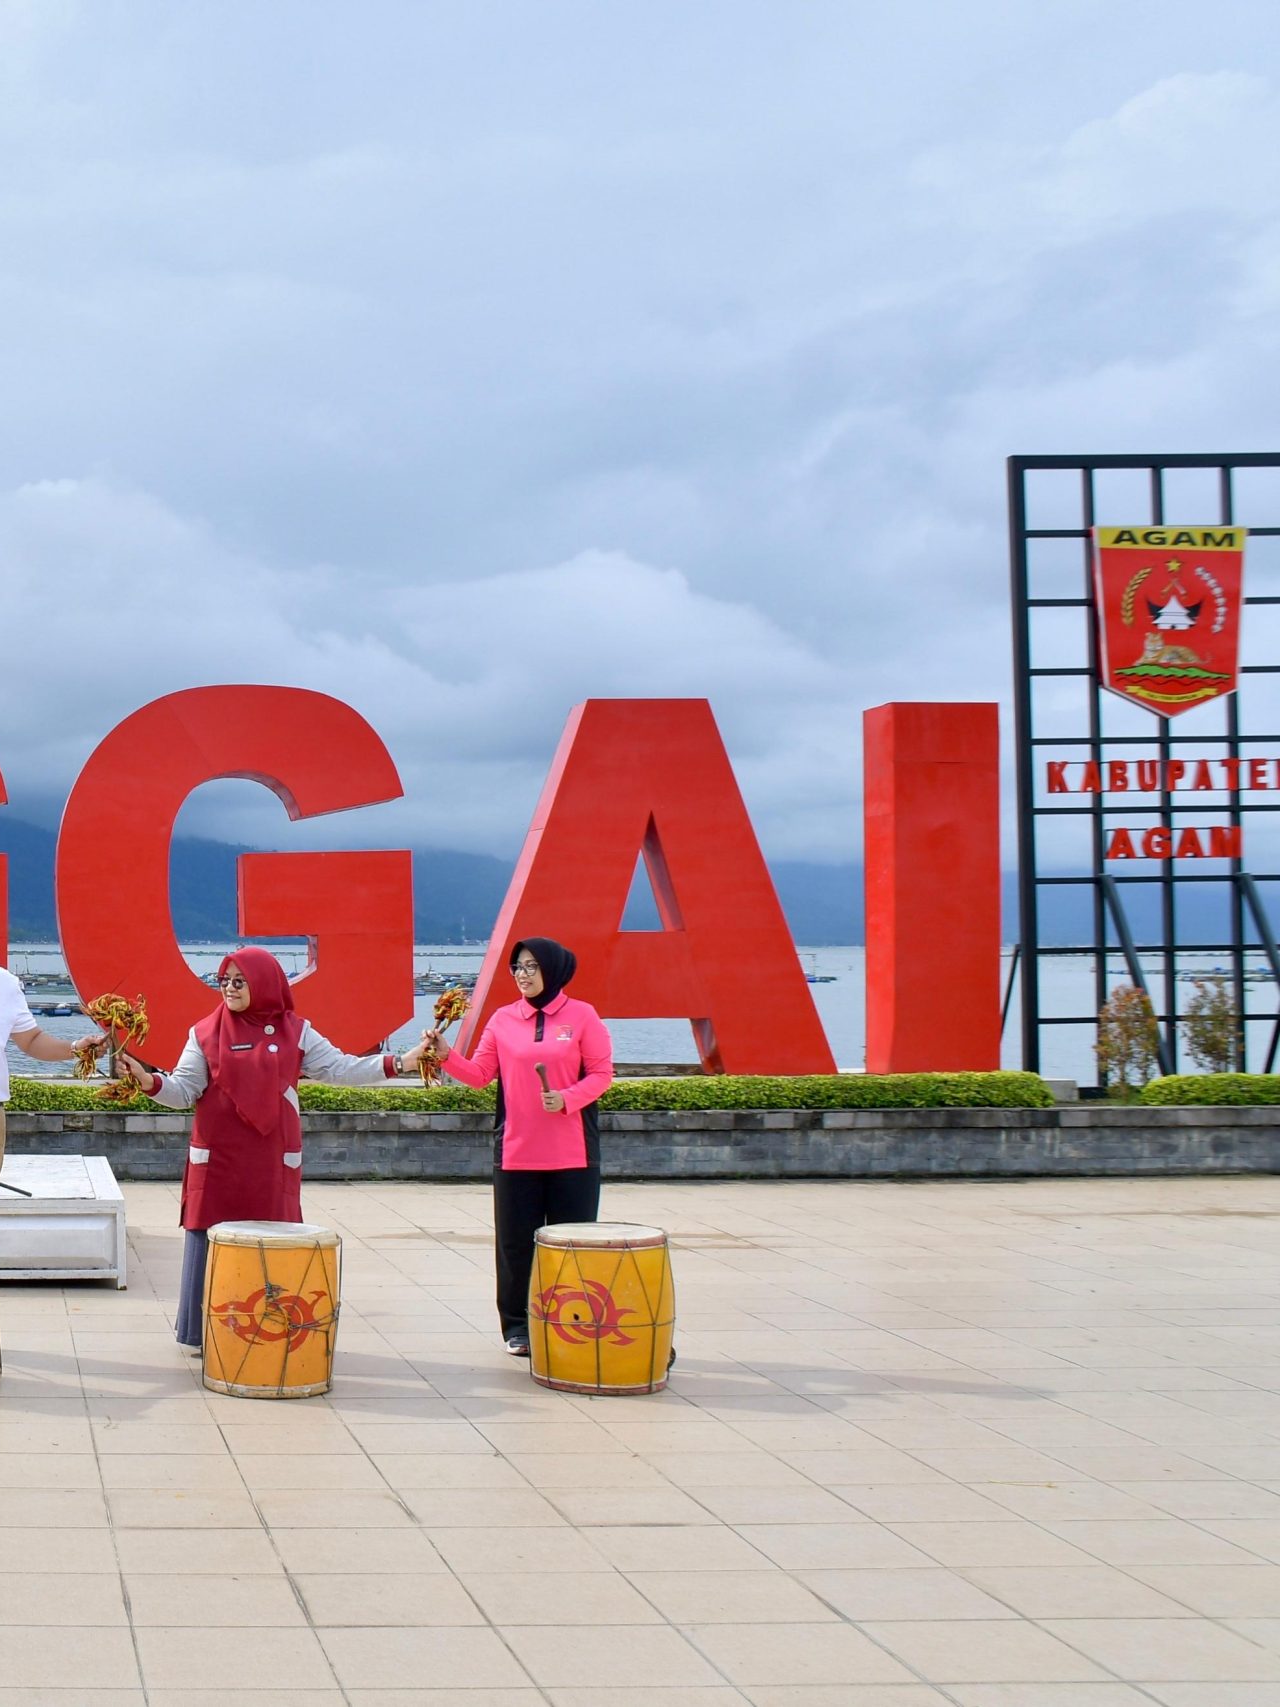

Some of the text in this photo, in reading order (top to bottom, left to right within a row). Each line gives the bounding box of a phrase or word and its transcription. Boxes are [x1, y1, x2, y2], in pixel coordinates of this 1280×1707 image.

[1111, 529, 1236, 547] AGAM
[1047, 757, 1280, 793] KABUPATE
[1105, 826, 1243, 860] AGAM
